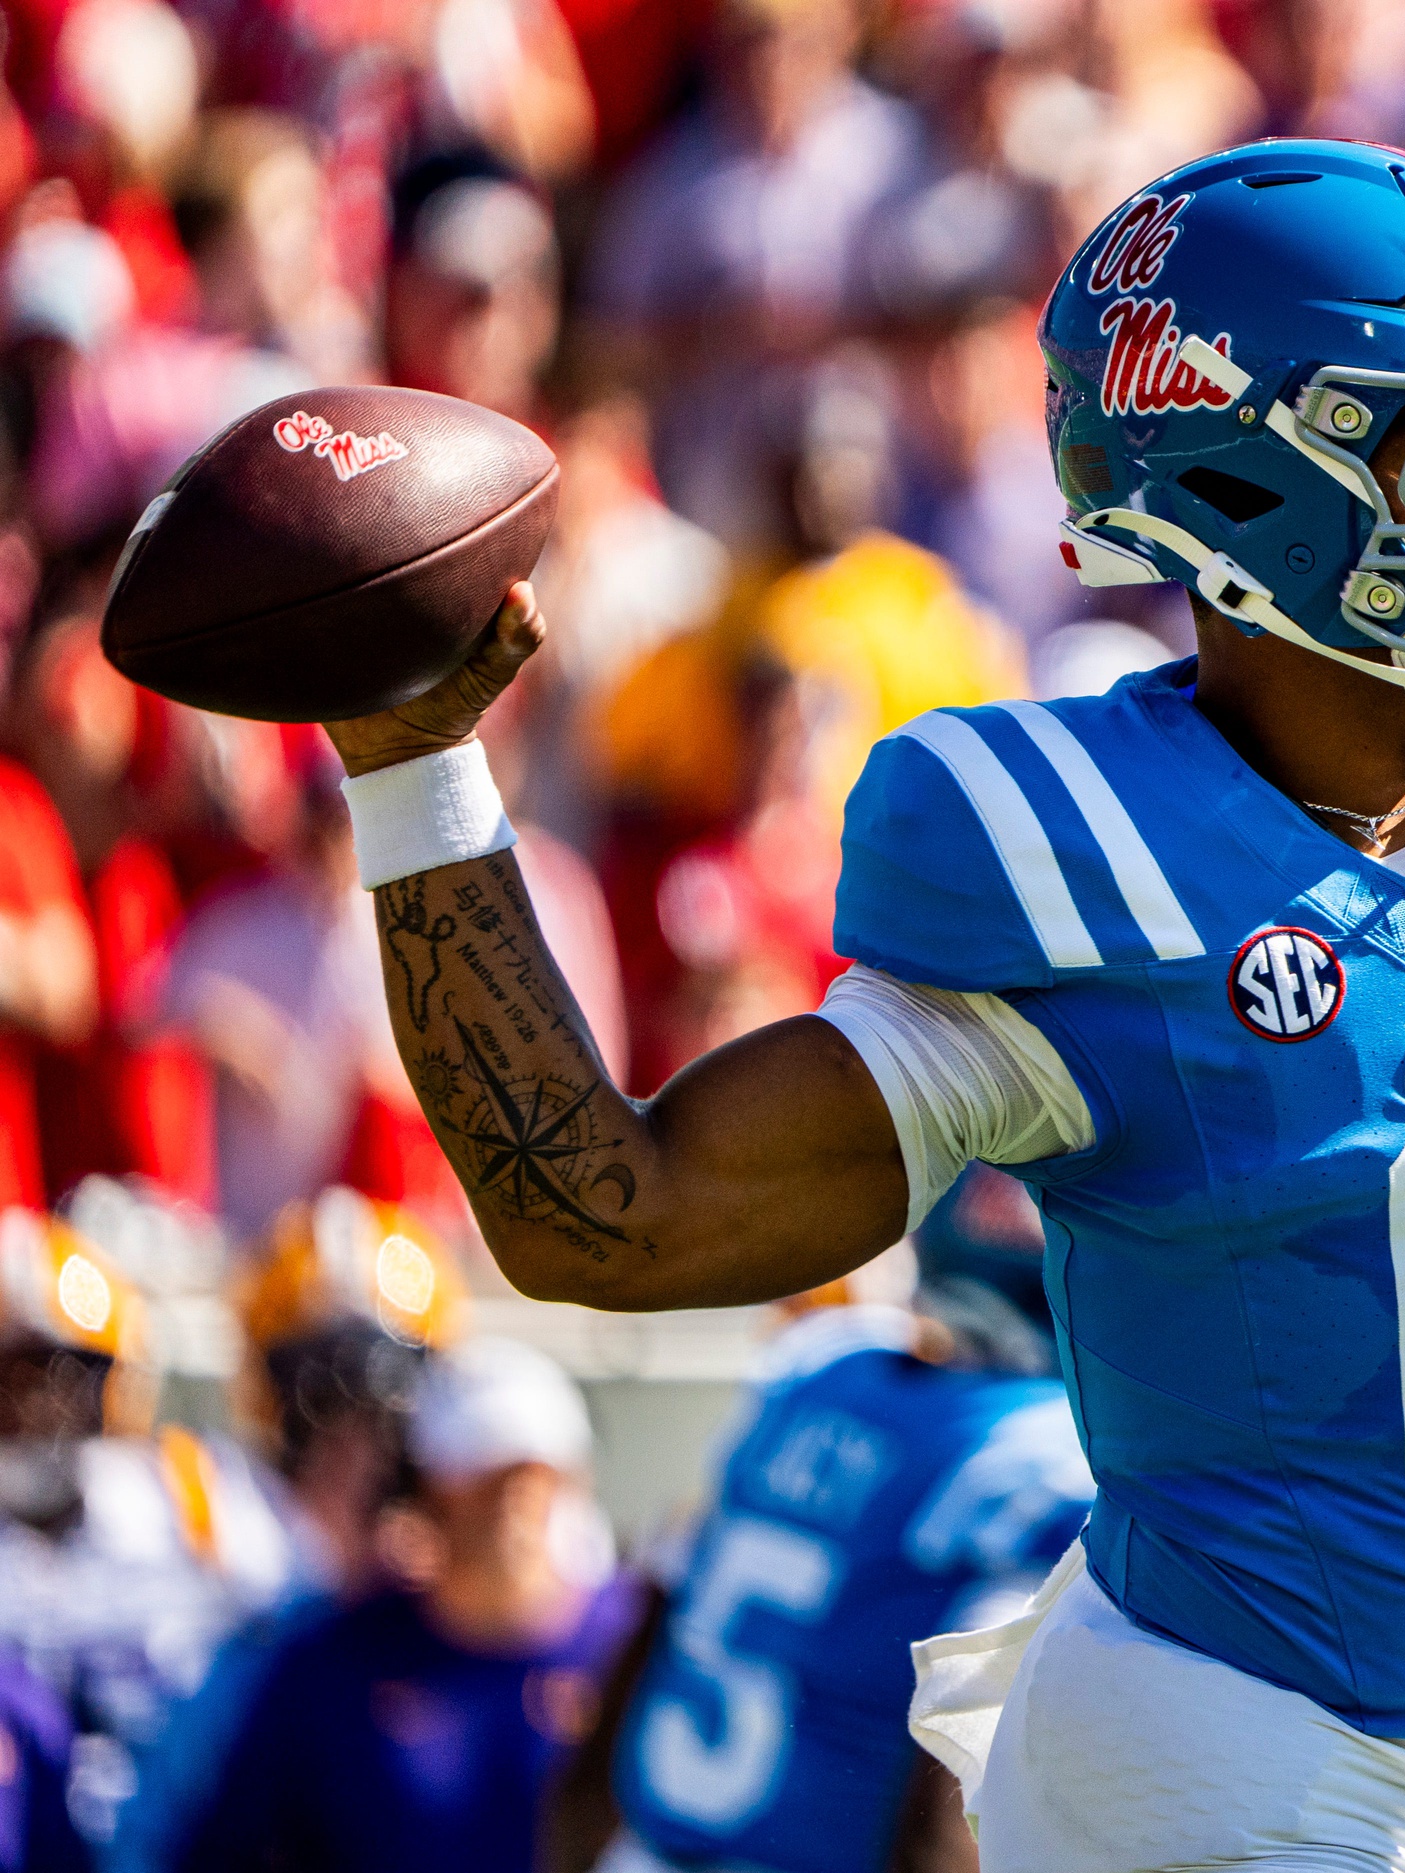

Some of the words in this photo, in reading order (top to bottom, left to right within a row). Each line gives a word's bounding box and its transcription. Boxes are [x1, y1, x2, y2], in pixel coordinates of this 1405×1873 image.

[1089, 194, 1189, 293] Ole
[273, 411, 333, 452] Ole
[314, 431, 410, 480] Miss
[457, 943, 506, 1004] Matthew
[504, 1003, 537, 1044] 19:26
[1237, 935, 1337, 1034] SEC
[643, 1518, 832, 1822] 5
